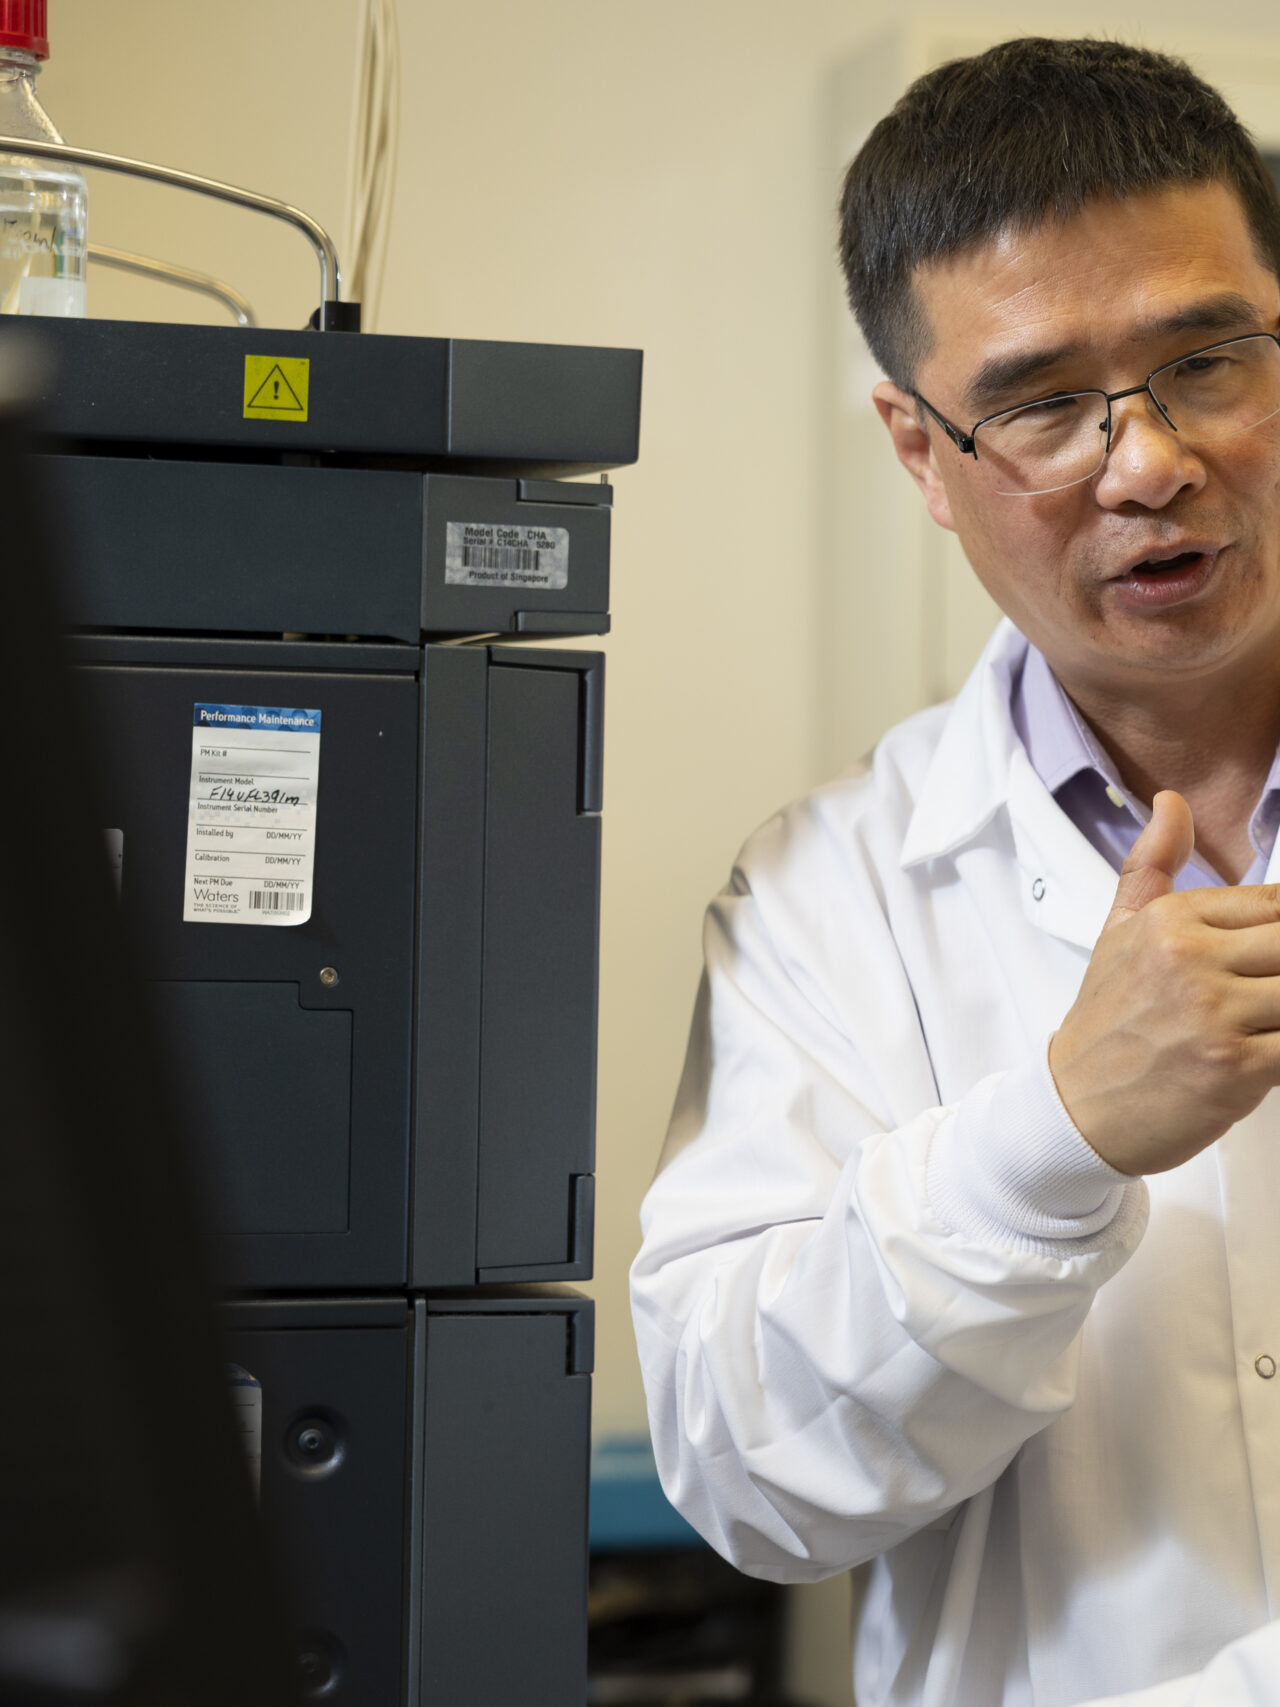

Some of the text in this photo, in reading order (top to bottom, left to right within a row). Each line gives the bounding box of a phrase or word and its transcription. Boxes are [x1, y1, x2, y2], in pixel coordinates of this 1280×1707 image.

[465, 528, 546, 540] Model Code CHA
[464, 537, 486, 545] Serial
[497, 539, 528, 547] C14CHA
[469, 571, 498, 579] Product
[510, 573, 548, 583] Singapore
[200, 710, 314, 726] Performance Maintenance
[199, 776, 233, 784] Instrument
[197, 803, 231, 811] Instrument
[196, 828, 303, 840] Installed by DD/MM/YY
[195, 853, 302, 865] Calibration DD/MM/YY
[264, 880, 299, 889] DD/MM/YY
[194, 888, 239, 902] Waters
